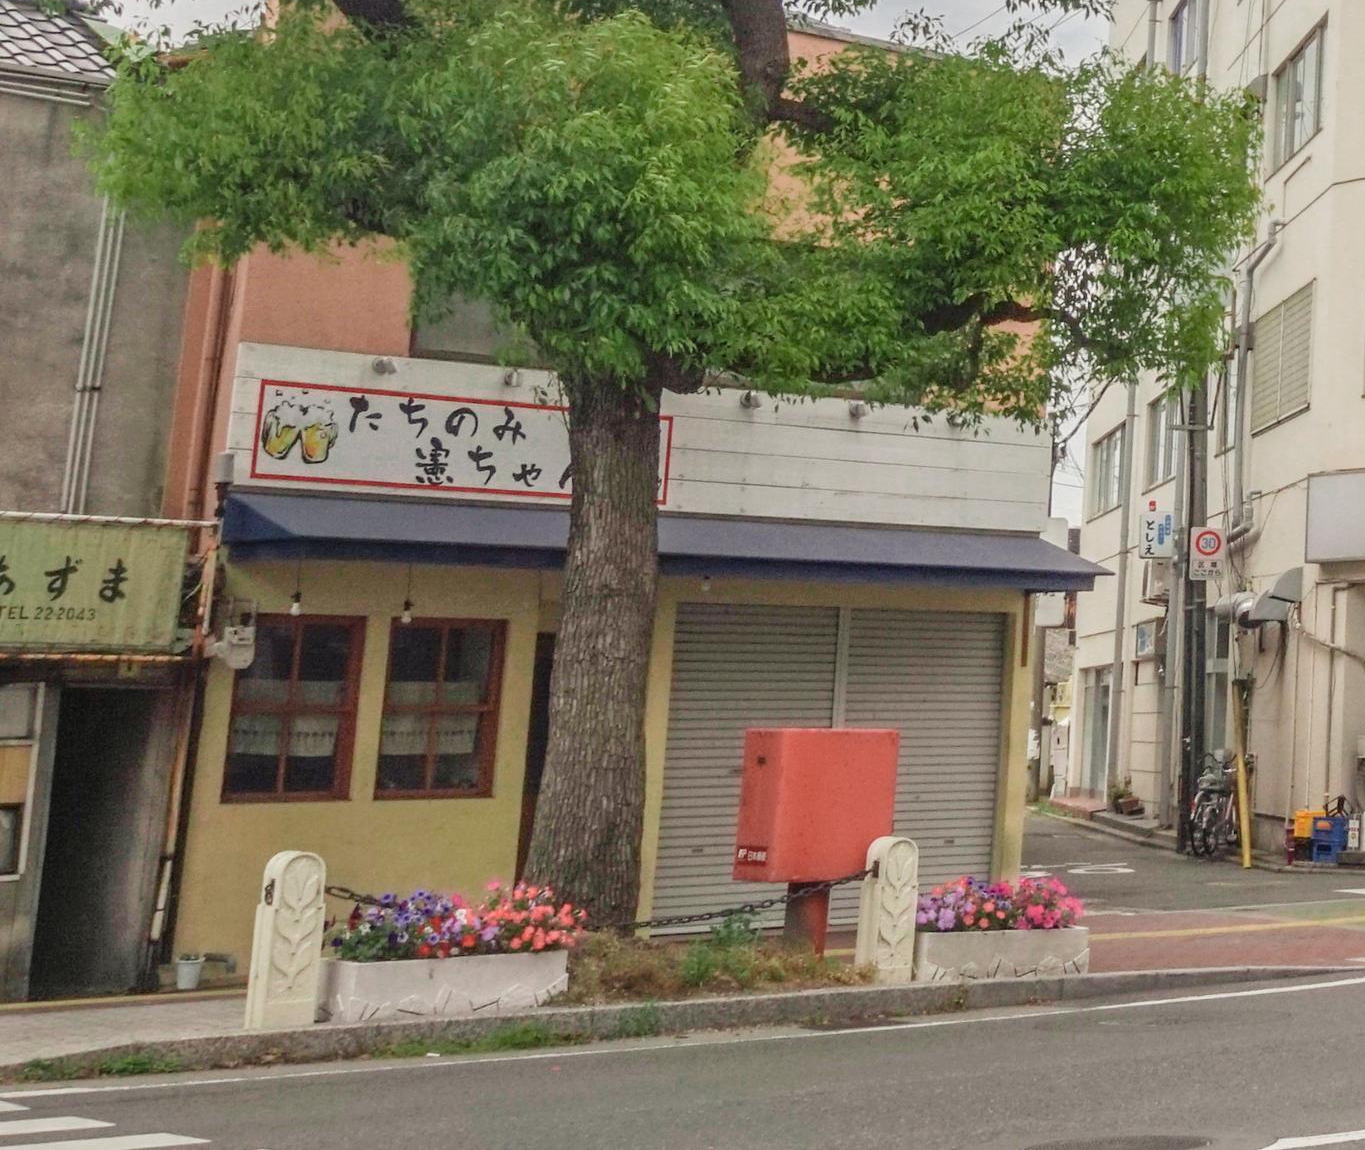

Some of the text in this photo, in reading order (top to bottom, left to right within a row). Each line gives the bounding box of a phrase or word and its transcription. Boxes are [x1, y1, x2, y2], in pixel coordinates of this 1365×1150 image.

[349, 395, 526, 445] たちのみ
[1145, 520, 1155, 555] としえ
[1201, 538, 1216, 549] 30
